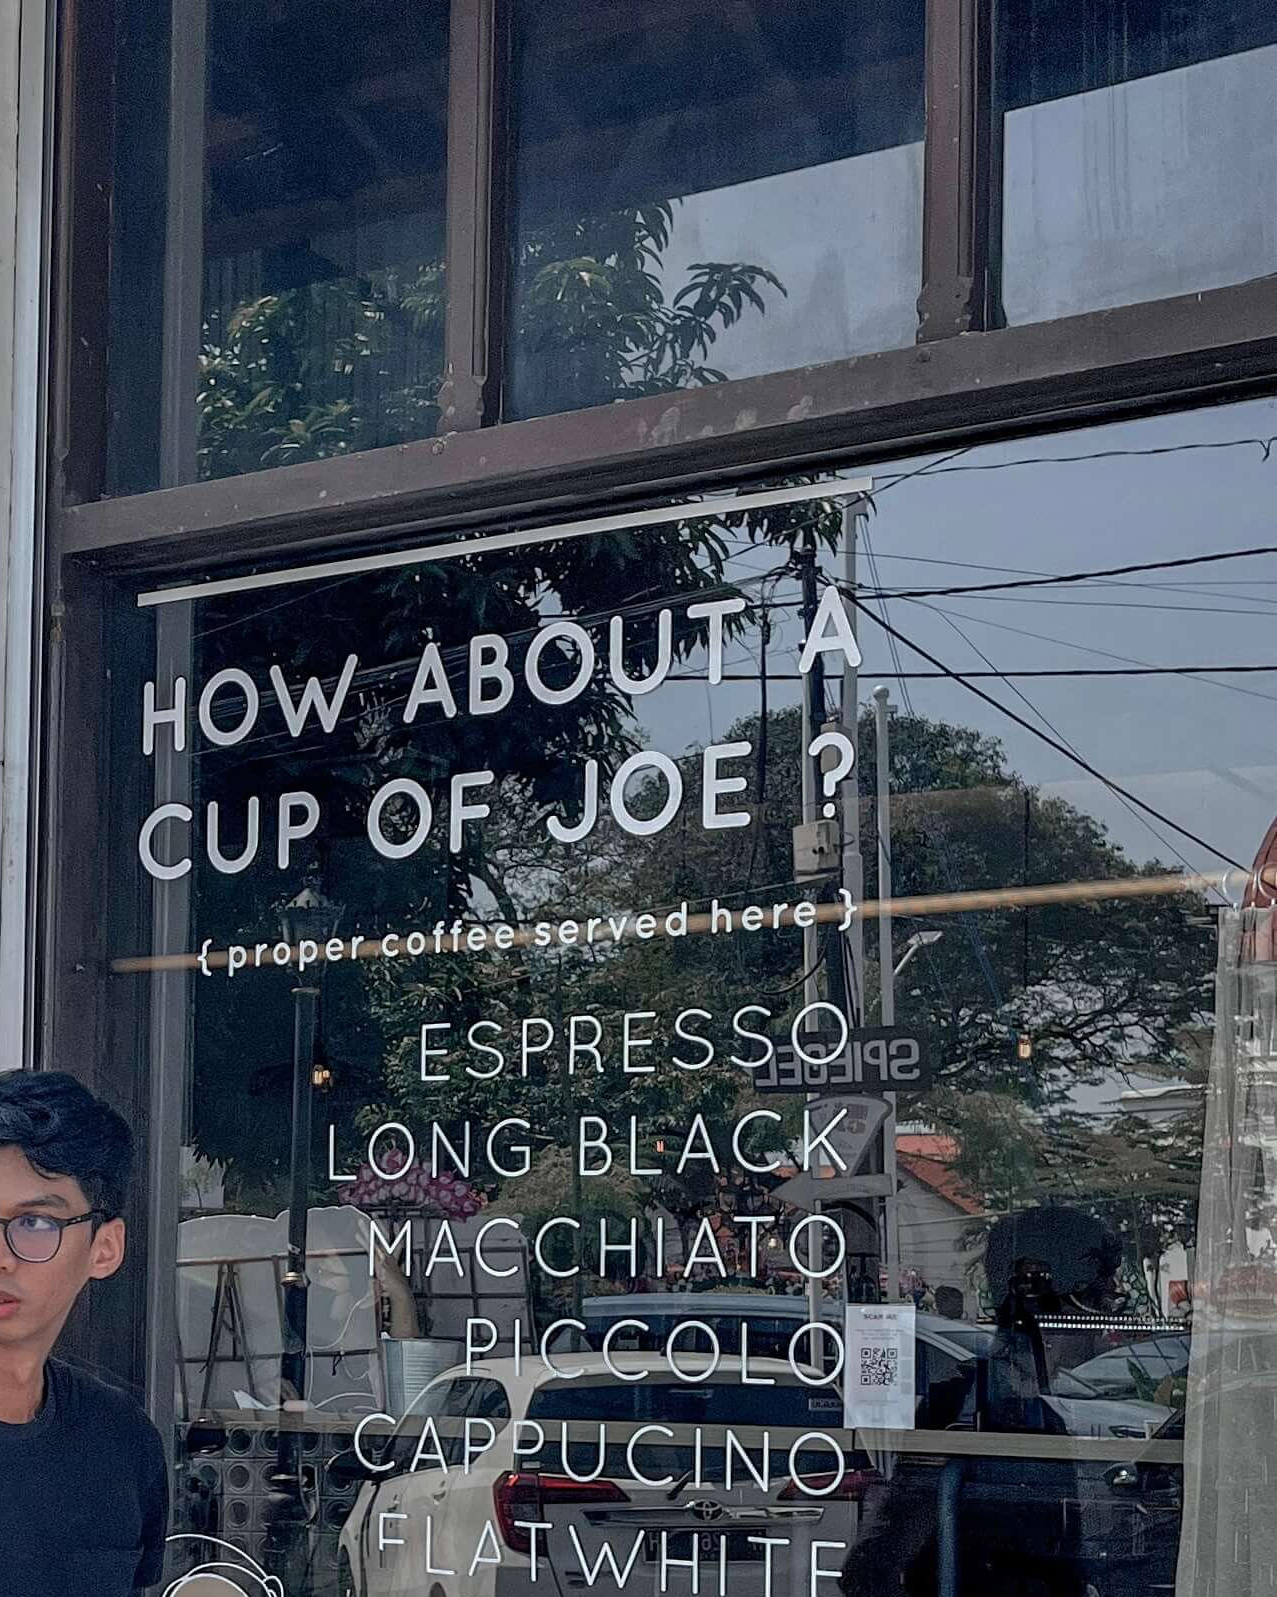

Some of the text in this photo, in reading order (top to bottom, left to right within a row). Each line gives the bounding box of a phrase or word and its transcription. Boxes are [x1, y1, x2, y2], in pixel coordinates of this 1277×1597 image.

[142, 584, 863, 756] HOW ABOUT A
[138, 790, 321, 881] CUP
[366, 769, 495, 860] OF
[545, 740, 753, 844] JOE
[227, 934, 365, 978] proper
[380, 918, 516, 958] coffee
[533, 900, 688, 947] served
[710, 898, 818, 935] here
[420, 1001, 849, 1082] ESPRESSO
[328, 1107, 849, 1182] LONG BLACK
[368, 1213, 846, 1279] MACCHIATO
[464, 1317, 845, 1388] PICCOLO
[353, 1412, 845, 1497] CAPPUCINO
